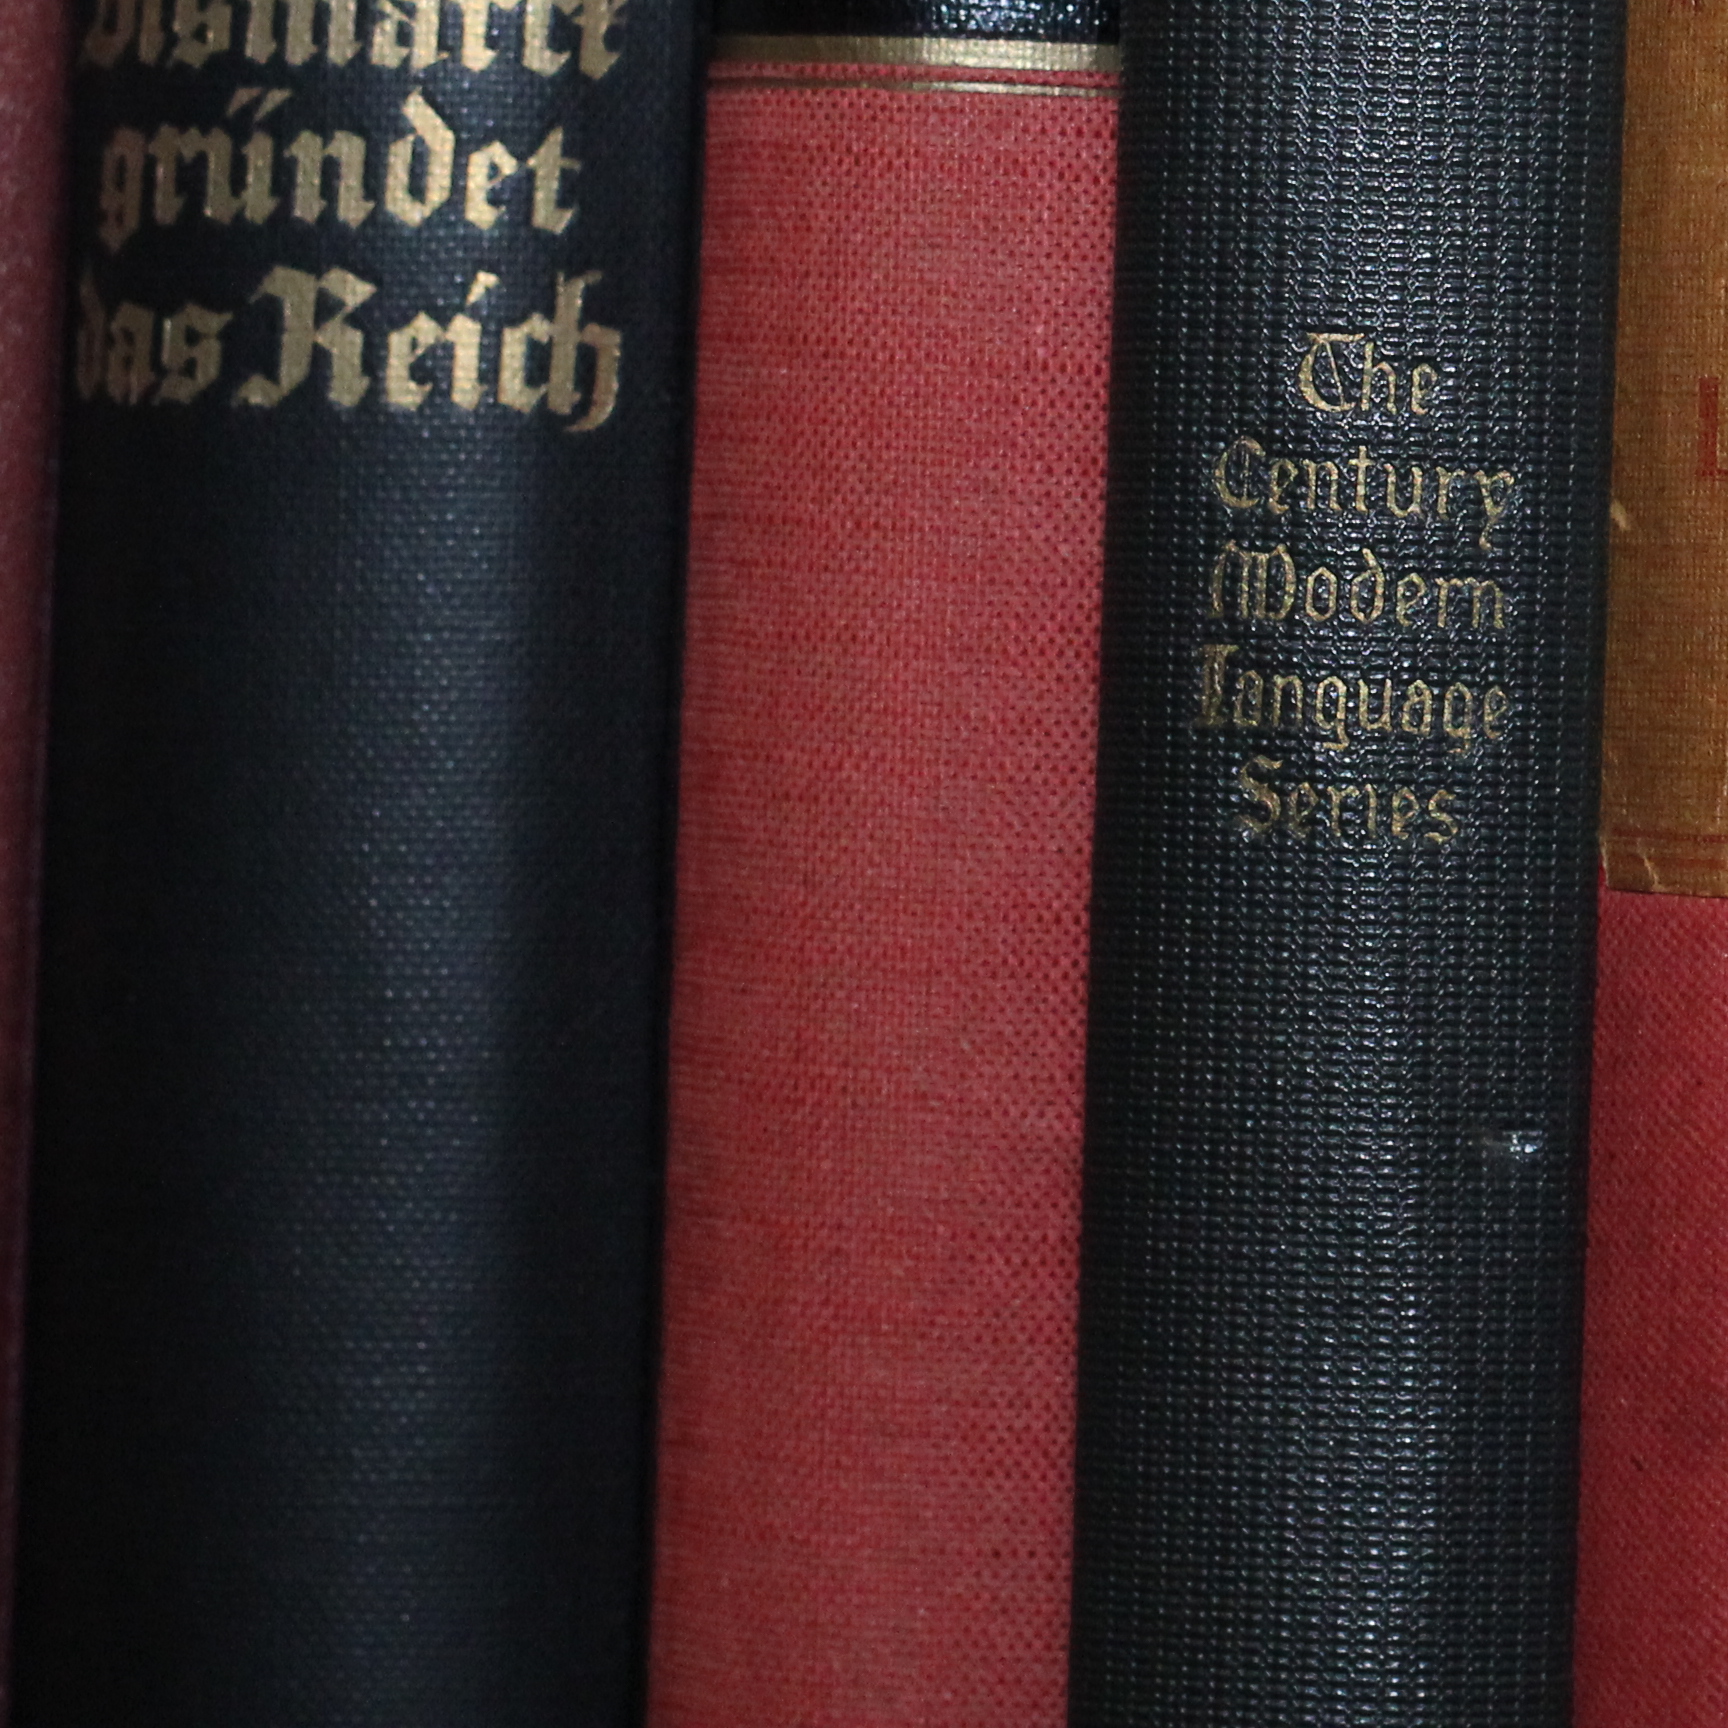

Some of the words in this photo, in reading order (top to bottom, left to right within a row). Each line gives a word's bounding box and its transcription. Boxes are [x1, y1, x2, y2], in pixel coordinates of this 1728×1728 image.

[1299, 331, 1439, 416] The
[1212, 435, 1516, 551] Century
[1207, 539, 1507, 631] Modern
[1237, 753, 1460, 845] Series
